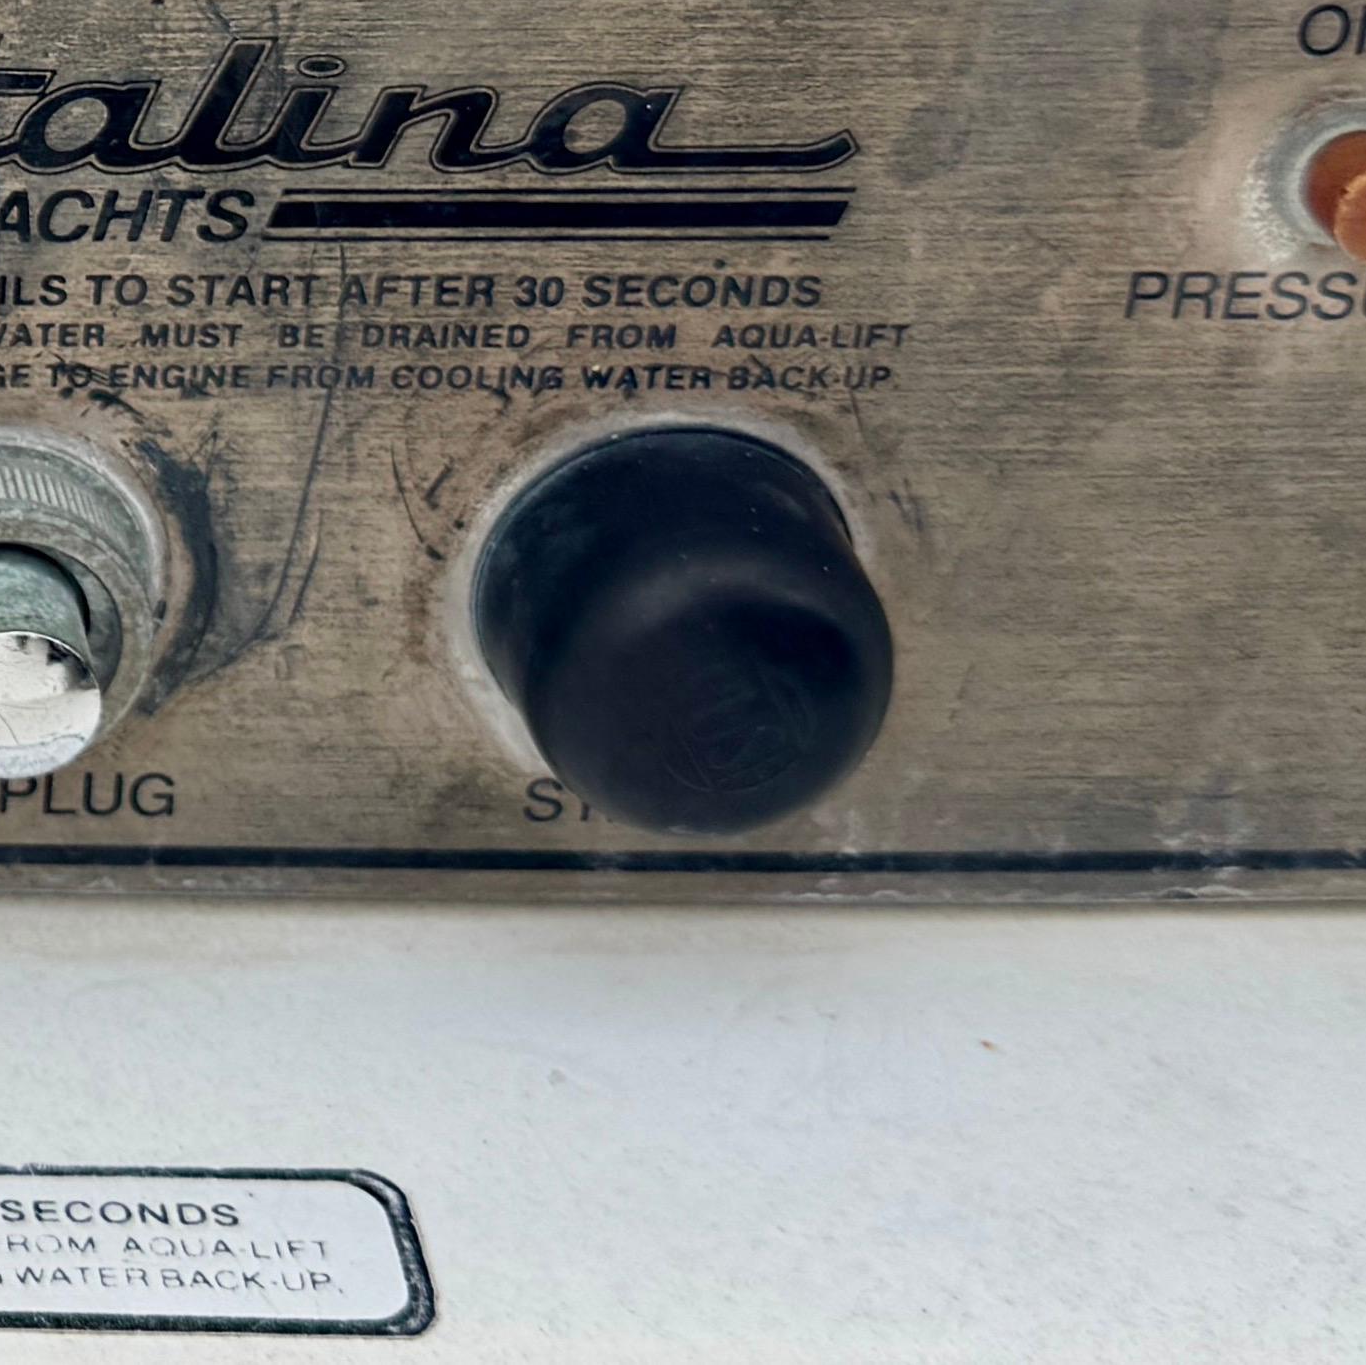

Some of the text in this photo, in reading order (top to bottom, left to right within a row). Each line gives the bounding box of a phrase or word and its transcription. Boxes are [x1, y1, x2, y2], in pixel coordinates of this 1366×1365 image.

[85, 274, 149, 306] TO
[167, 274, 320, 306] START
[339, 274, 495, 307] AFTER
[513, 275, 564, 307] 30
[582, 274, 823, 308] SECONDS
[1124, 270, 1366, 320] PRESS
[140, 323, 242, 347] MUST
[278, 323, 324, 348] BE
[362, 324, 531, 349] DRAINED
[568, 324, 676, 349] FROM
[711, 324, 910, 349] AQUA-LIFT
[47, 364, 92, 388] TO
[109, 364, 249, 388] ENGINE
[268, 365, 374, 388] FROM
[391, 365, 564, 390] COOLING
[581, 365, 711, 390] WATER
[0, 1199, 240, 1227] SECONDS
[122, 1236, 328, 1262] AQUA-LIFT
[14, 1264, 153, 1289] WATER
